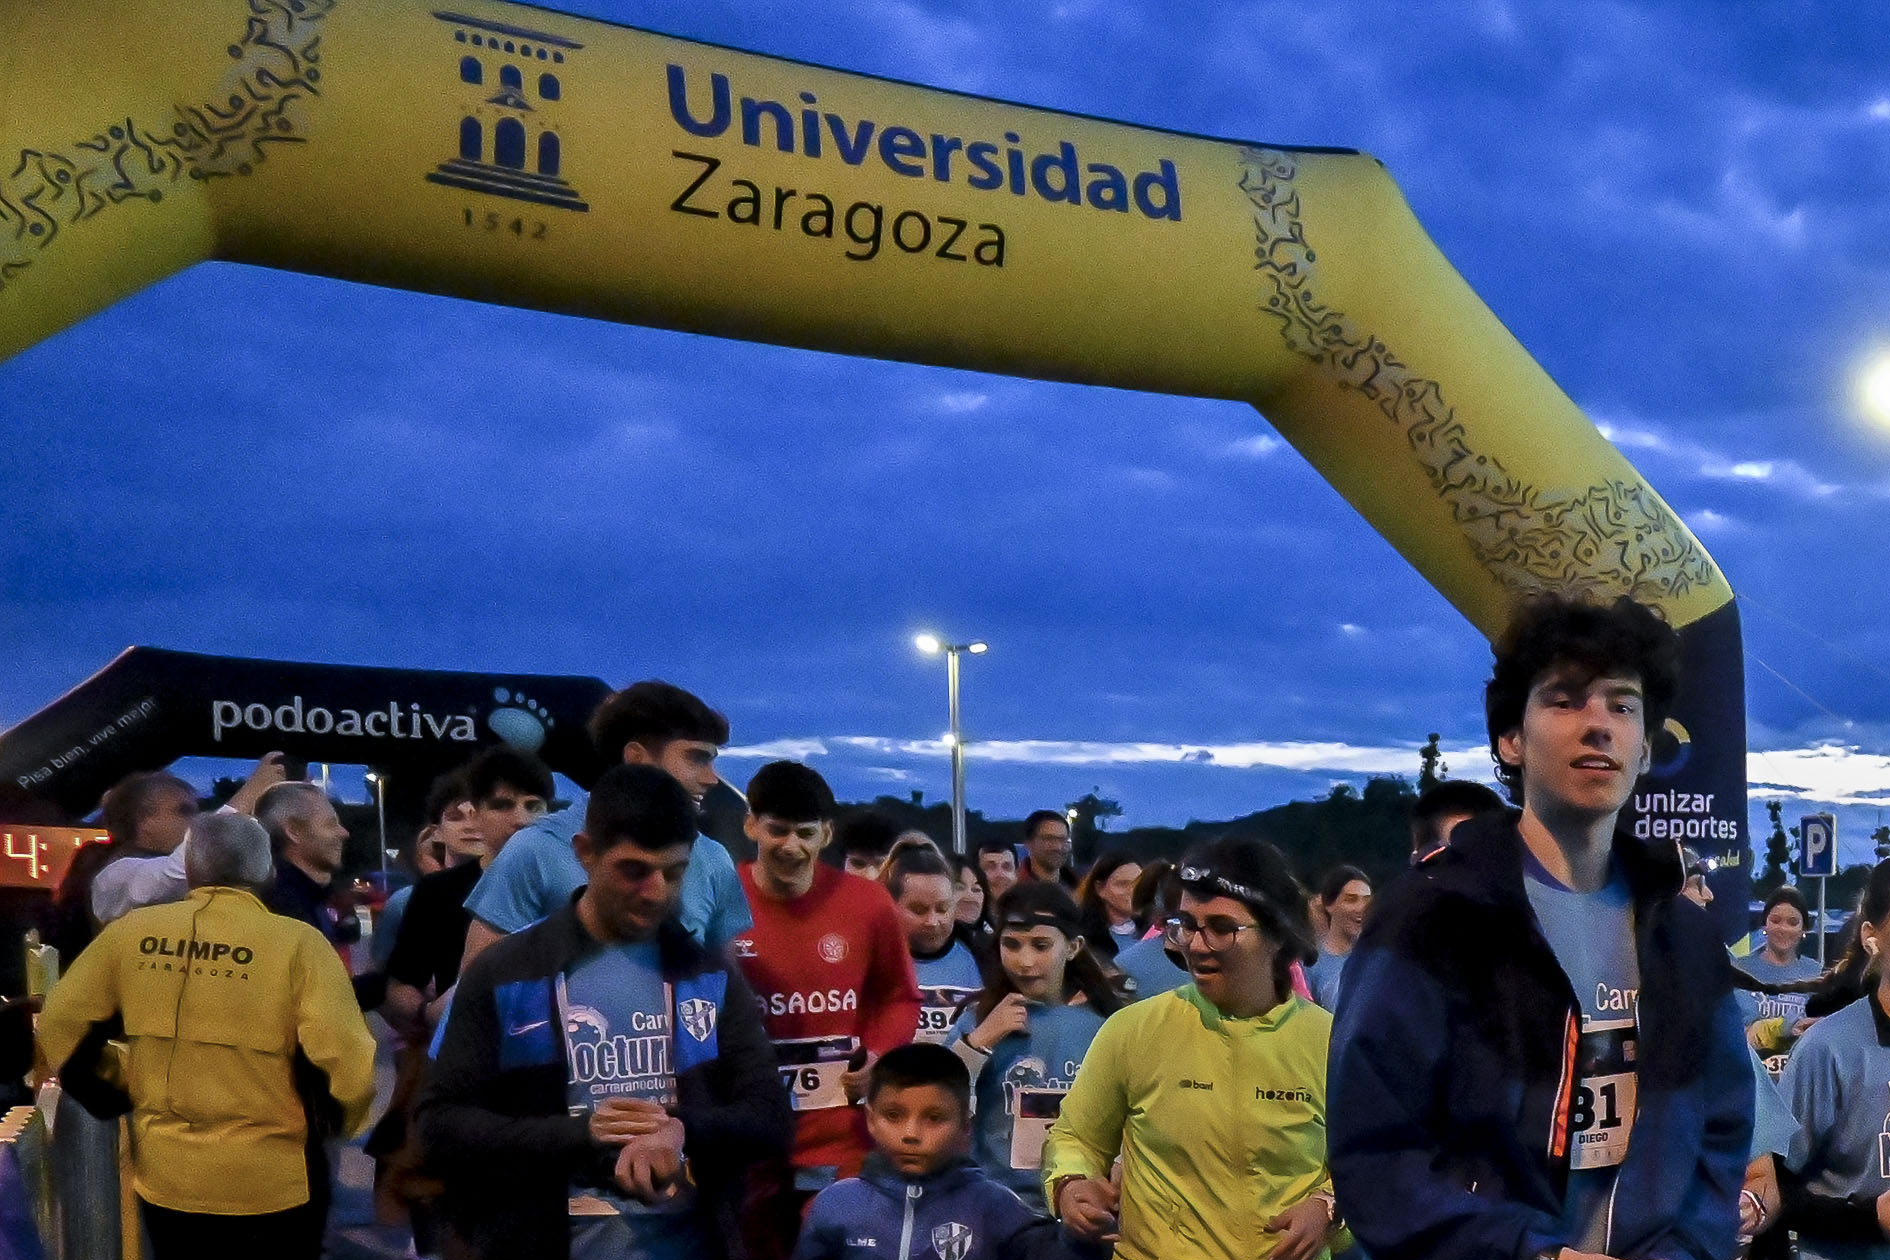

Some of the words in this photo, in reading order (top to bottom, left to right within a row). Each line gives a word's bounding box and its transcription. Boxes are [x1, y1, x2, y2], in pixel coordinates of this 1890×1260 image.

[666, 63, 1183, 222] Universidad
[464, 207, 547, 239] 1542
[670, 149, 1007, 268] Zaragoza
[213, 696, 478, 742] podoactiva
[88, 724, 118, 746] vive
[1634, 788, 1715, 813] unizar
[1634, 813, 1738, 841] deportes
[1807, 823, 1827, 869] P
[140, 936, 253, 965] OLIMPO
[138, 961, 249, 981] ZARAGOZA
[1578, 1132, 1609, 1145] DIEGO
